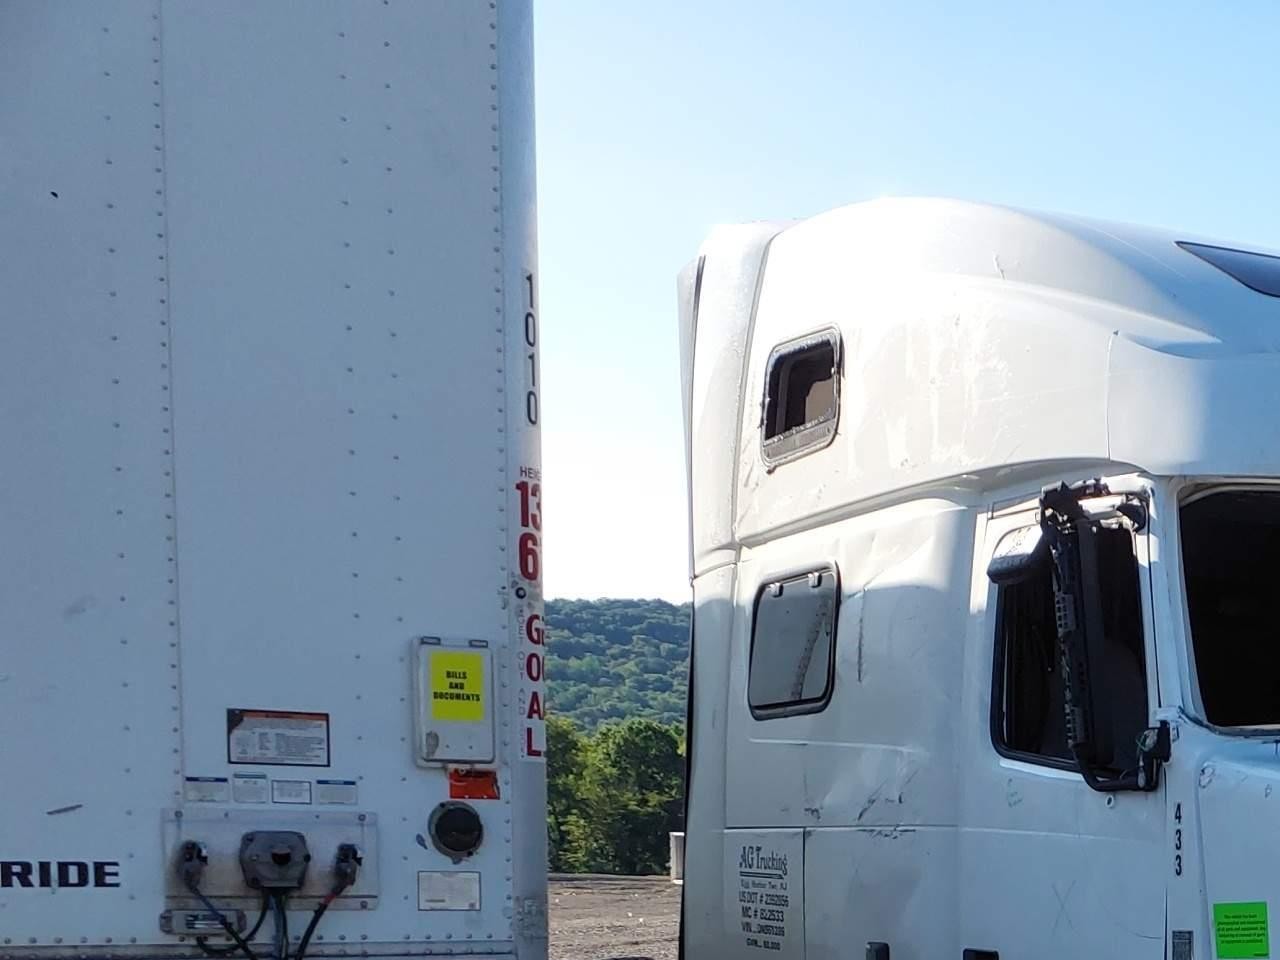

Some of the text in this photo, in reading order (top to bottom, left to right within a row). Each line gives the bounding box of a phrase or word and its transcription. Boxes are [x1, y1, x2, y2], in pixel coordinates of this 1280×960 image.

[525, 273, 538, 425] 1010
[446, 670, 468, 680] BILLS
[448, 682, 465, 690] AND
[526, 614, 544, 756] GOAL
[433, 691, 481, 702] DOCUMENTS
[1174, 803, 1182, 876] 433
[0, 861, 121, 888] RIDE
[739, 846, 788, 876] AG Trucking
